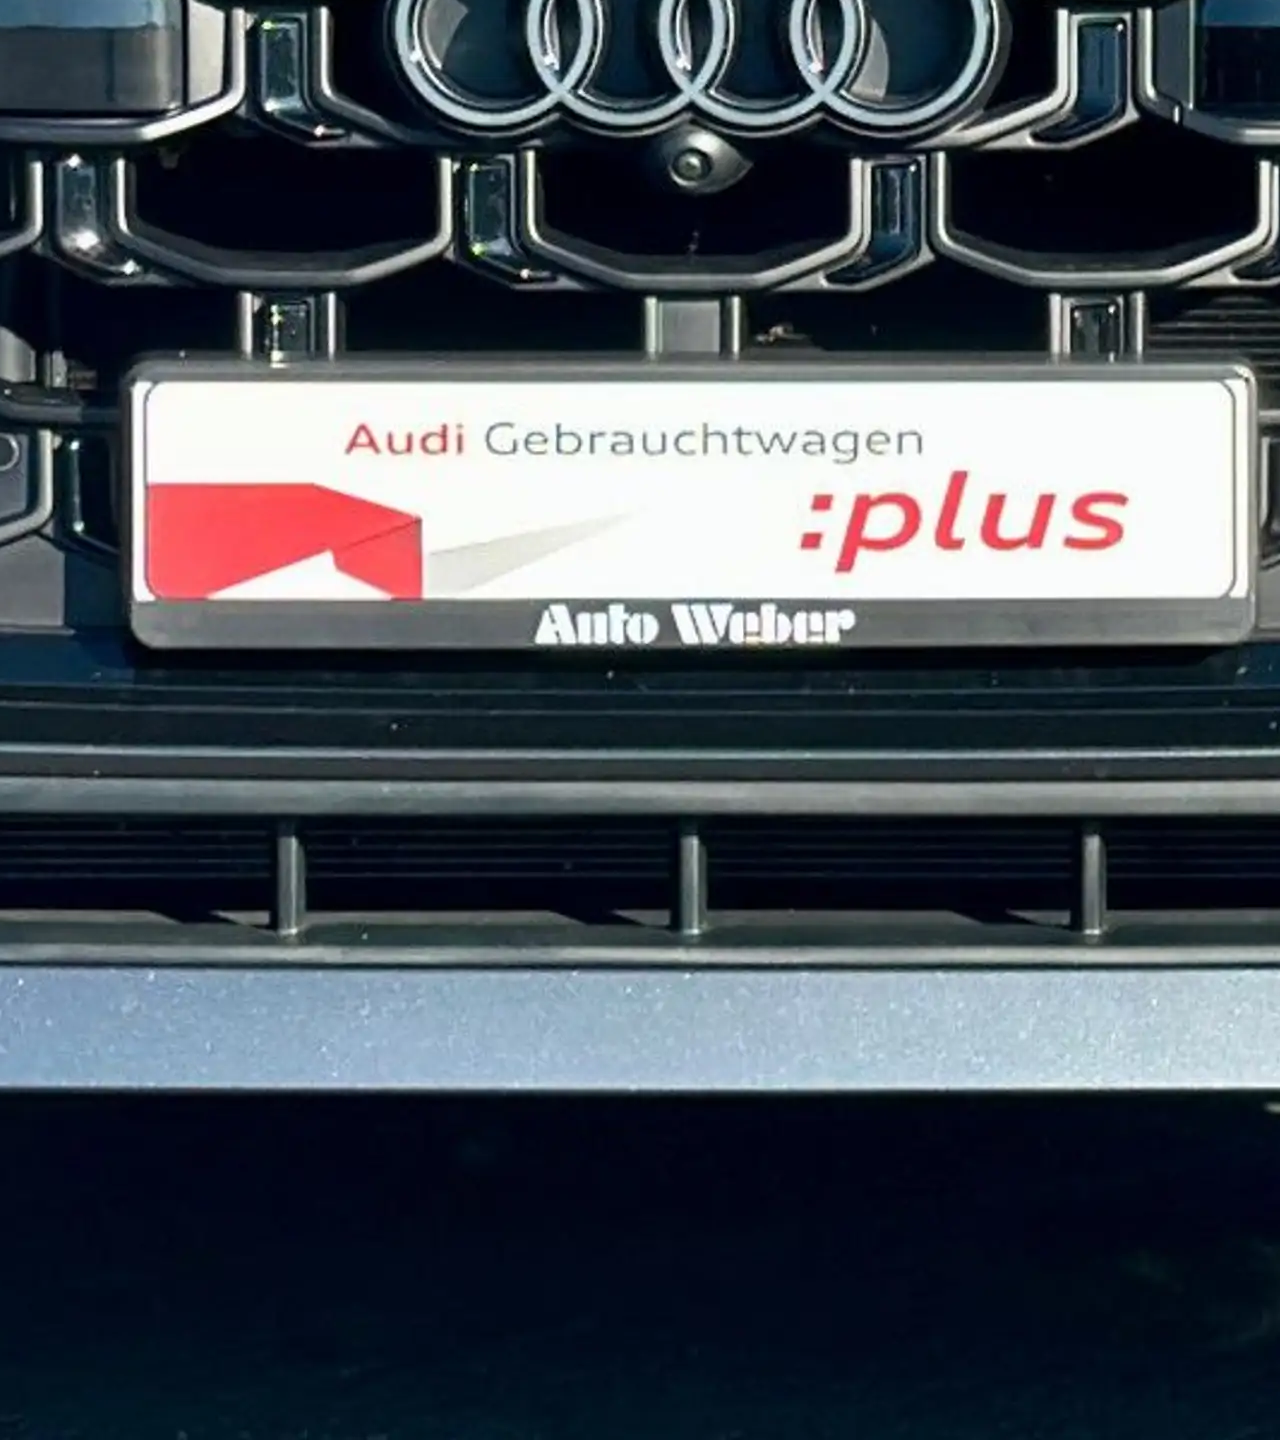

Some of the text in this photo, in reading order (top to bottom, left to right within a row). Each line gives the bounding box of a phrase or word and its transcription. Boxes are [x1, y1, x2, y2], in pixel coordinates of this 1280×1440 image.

[344, 421, 924, 465] Audi Gebrauchtwagen
[799, 470, 1129, 574] :plus
[534, 602, 857, 646] Auto Weber
